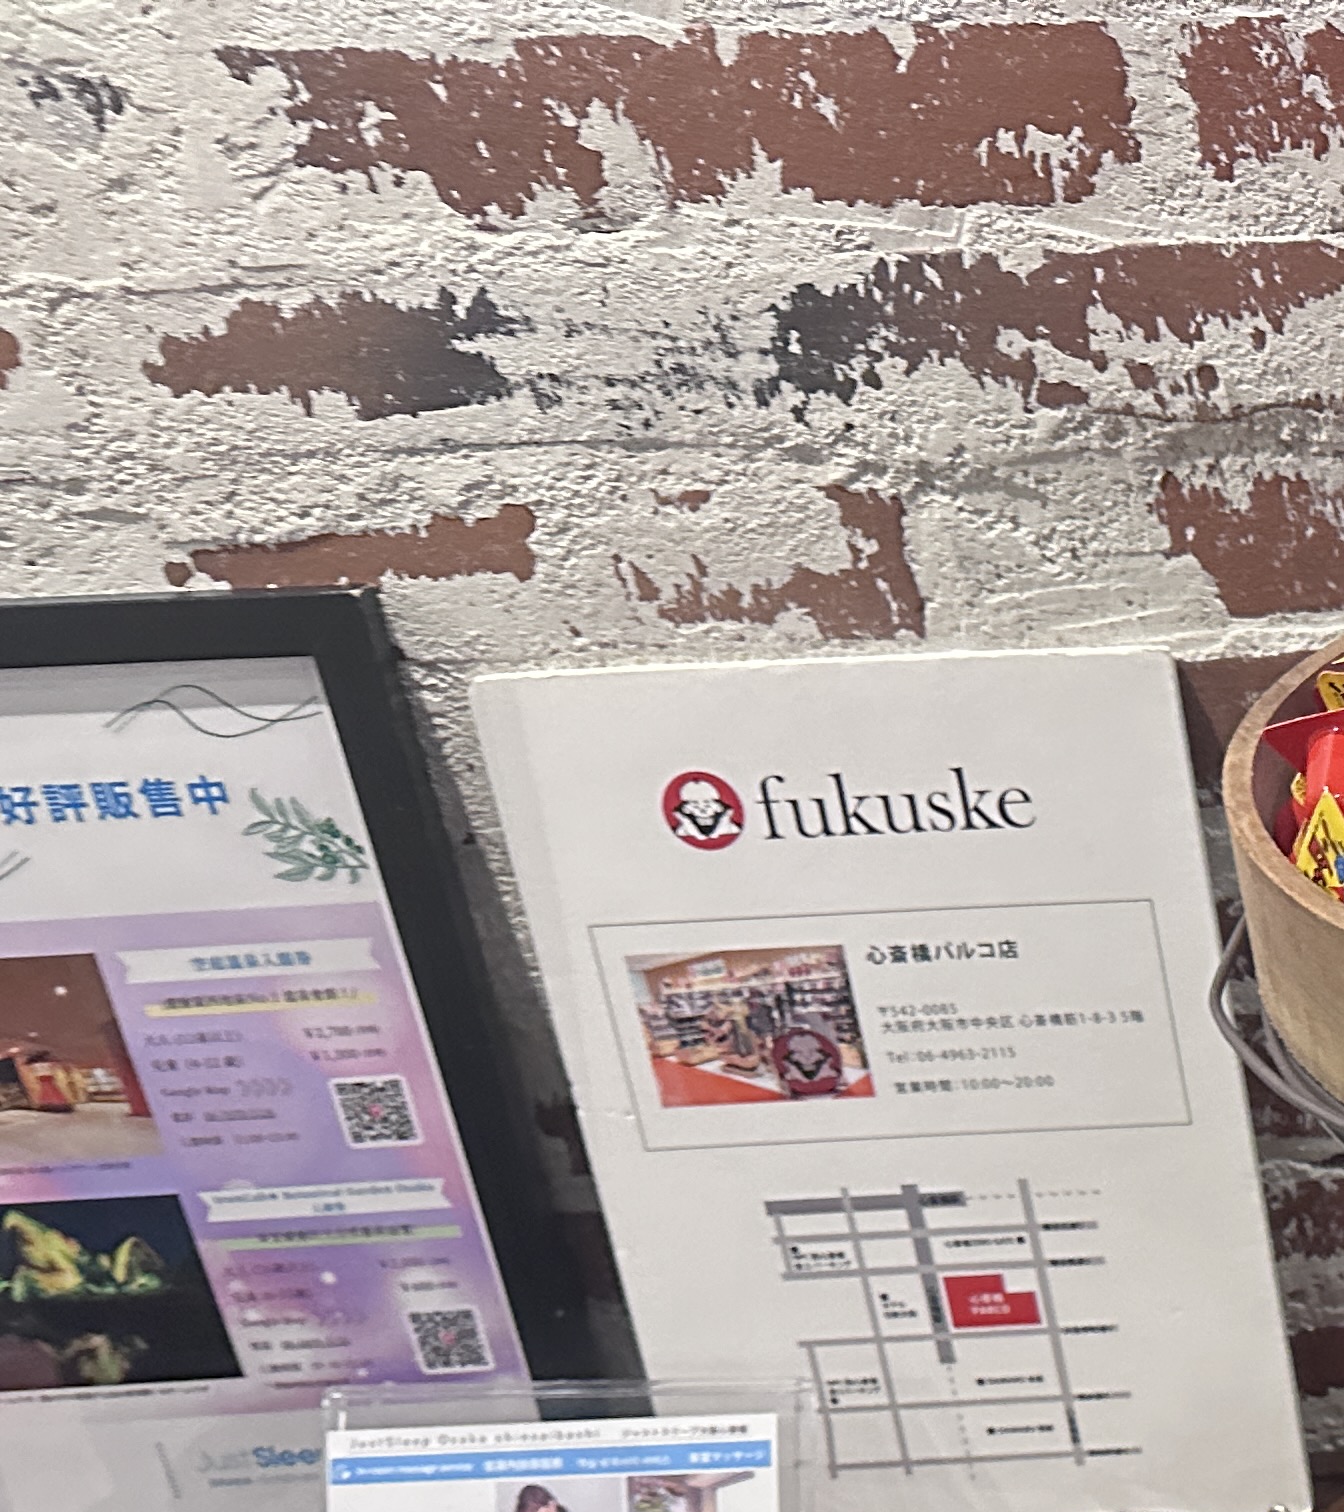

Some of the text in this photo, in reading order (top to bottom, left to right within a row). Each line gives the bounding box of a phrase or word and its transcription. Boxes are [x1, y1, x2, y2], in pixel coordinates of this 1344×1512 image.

[0, 774, 230, 825] 好評販售中
[755, 768, 1037, 841] fukuske
[866, 940, 1018, 965] 心斎橋パルコ店
